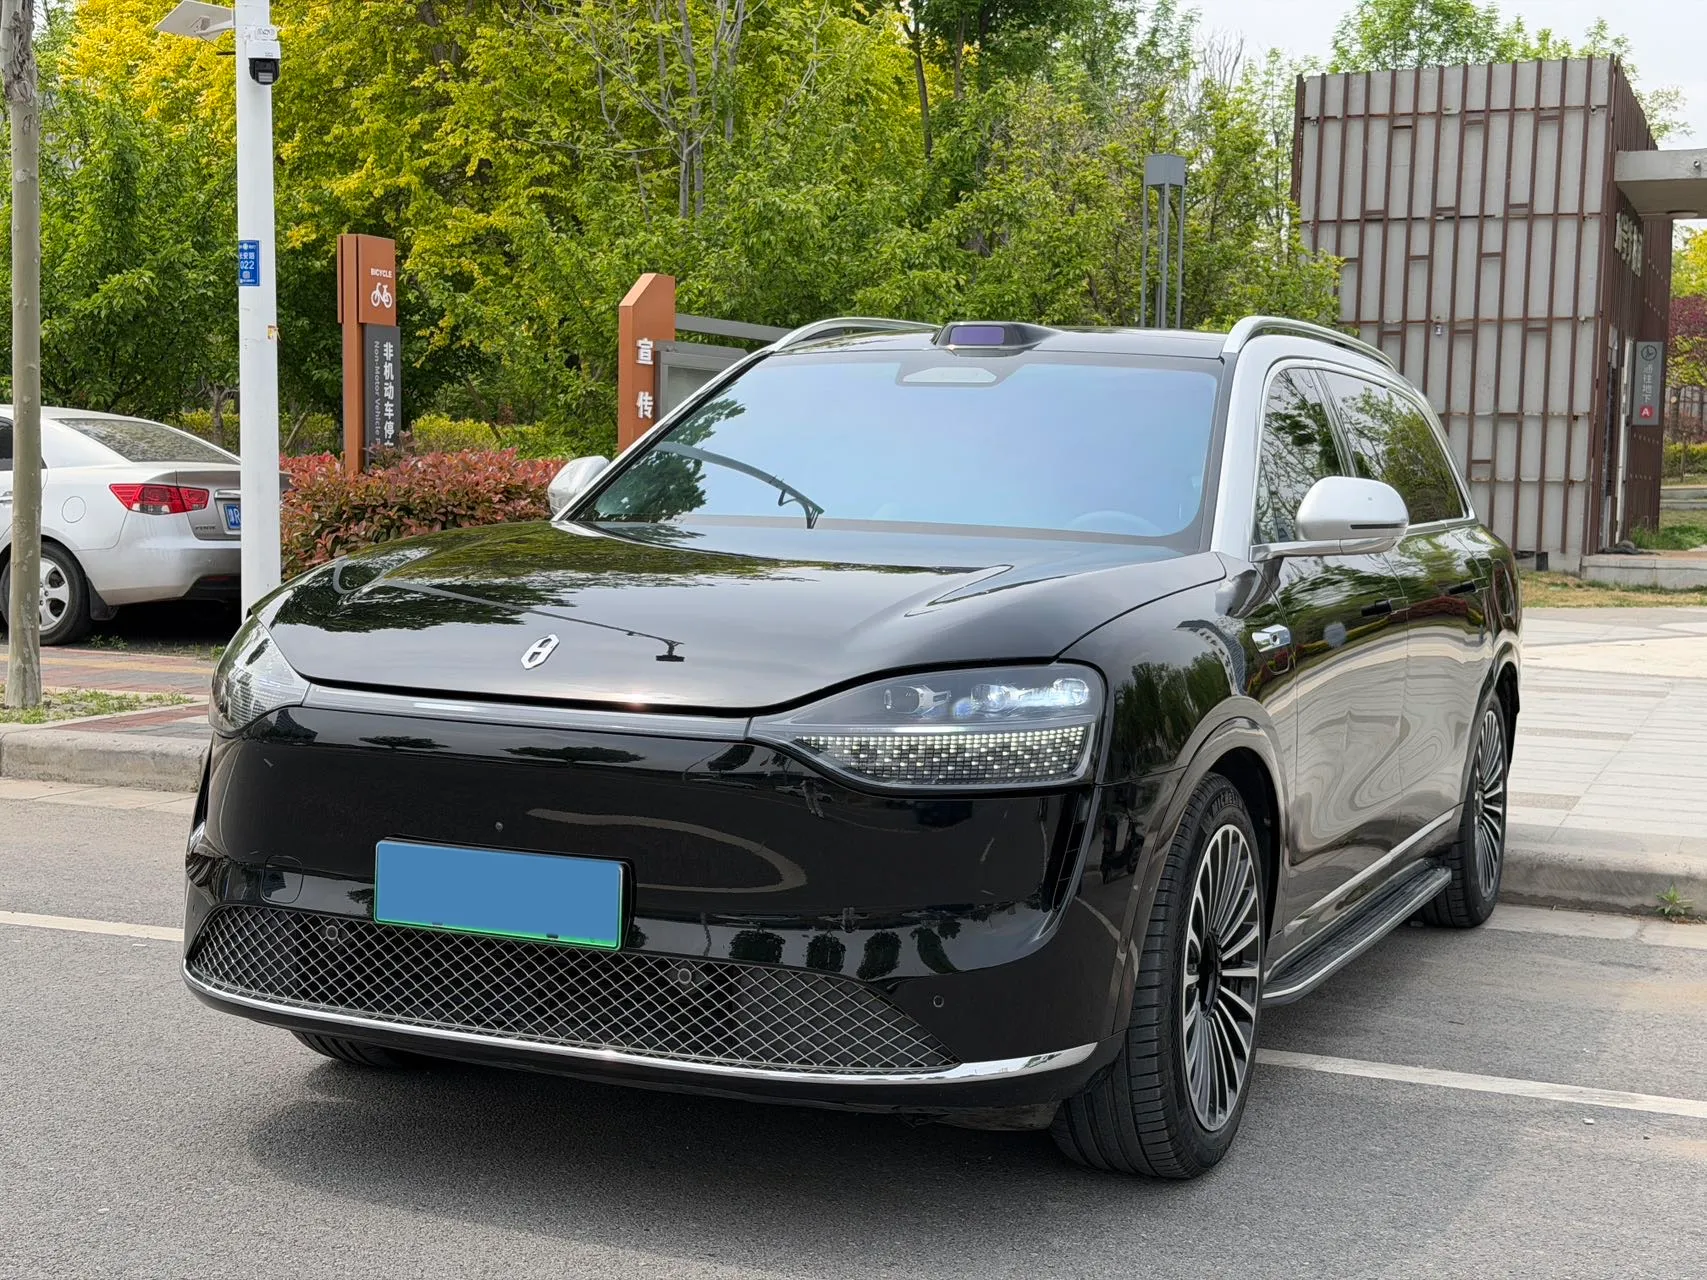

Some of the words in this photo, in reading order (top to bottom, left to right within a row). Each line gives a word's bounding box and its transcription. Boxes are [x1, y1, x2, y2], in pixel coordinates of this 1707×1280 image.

[370, 267, 392, 279] BICYCLE
[636, 337, 654, 420] 宣传
[1641, 407, 1650, 417] A
